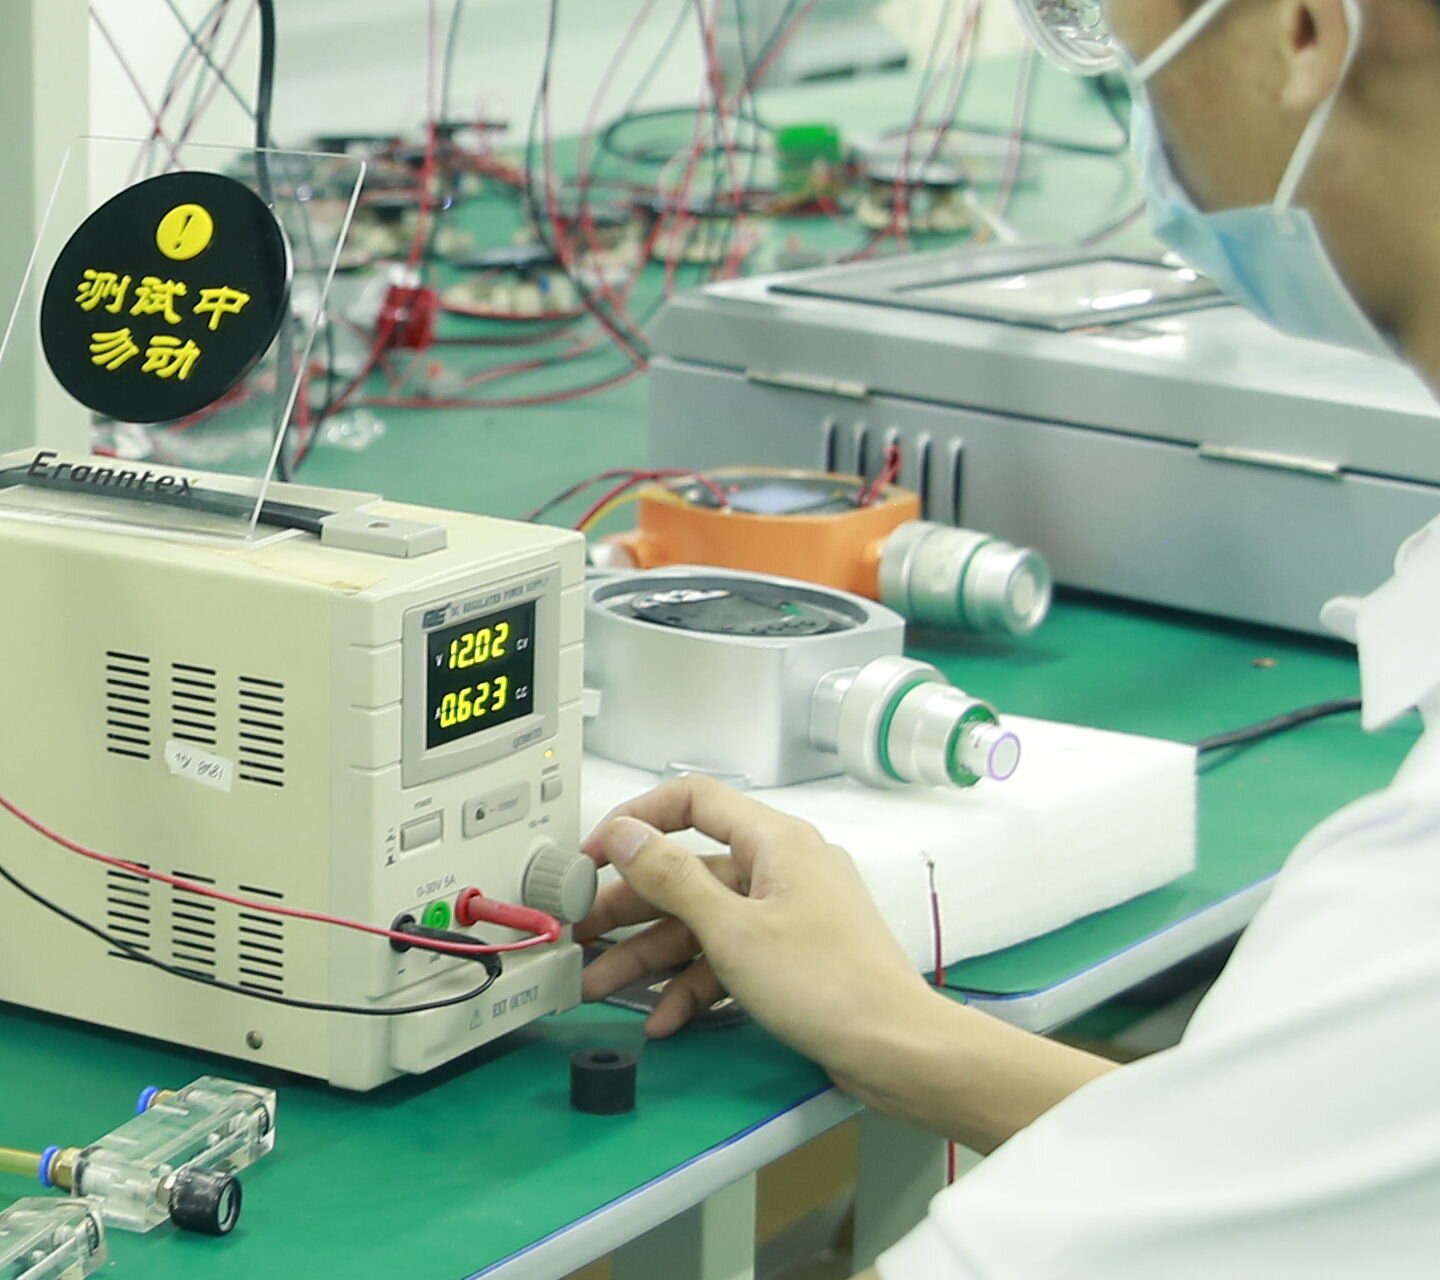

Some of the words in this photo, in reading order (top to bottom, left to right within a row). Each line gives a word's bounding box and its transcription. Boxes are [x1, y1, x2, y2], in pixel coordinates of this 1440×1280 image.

[74, 268, 251, 331] 测试中
[88, 327, 202, 381] 勿动
[27, 451, 200, 496] Eranntex
